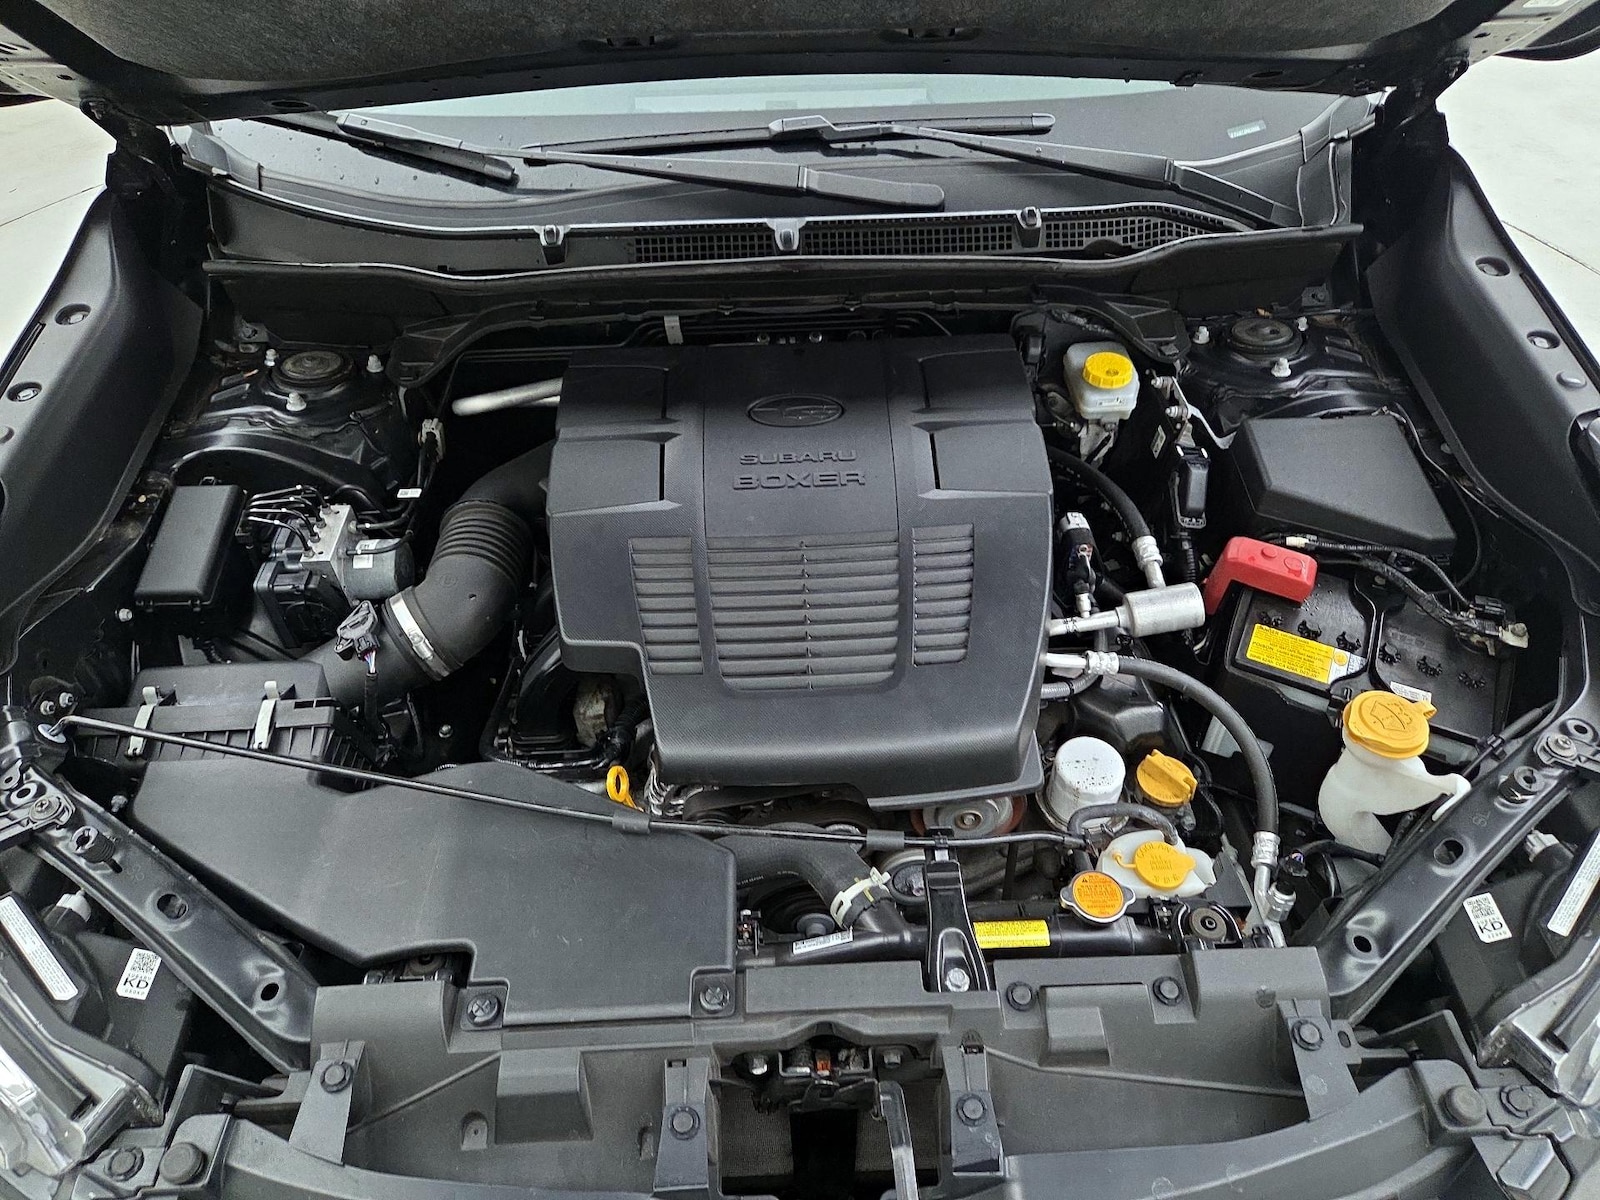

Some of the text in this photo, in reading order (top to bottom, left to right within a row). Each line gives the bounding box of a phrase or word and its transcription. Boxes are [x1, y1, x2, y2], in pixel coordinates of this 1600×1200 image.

[739, 450, 858, 466] SUBARU
[732, 472, 866, 490] BOXER
[1478, 921, 1503, 934] KD
[123, 977, 149, 989] KD
